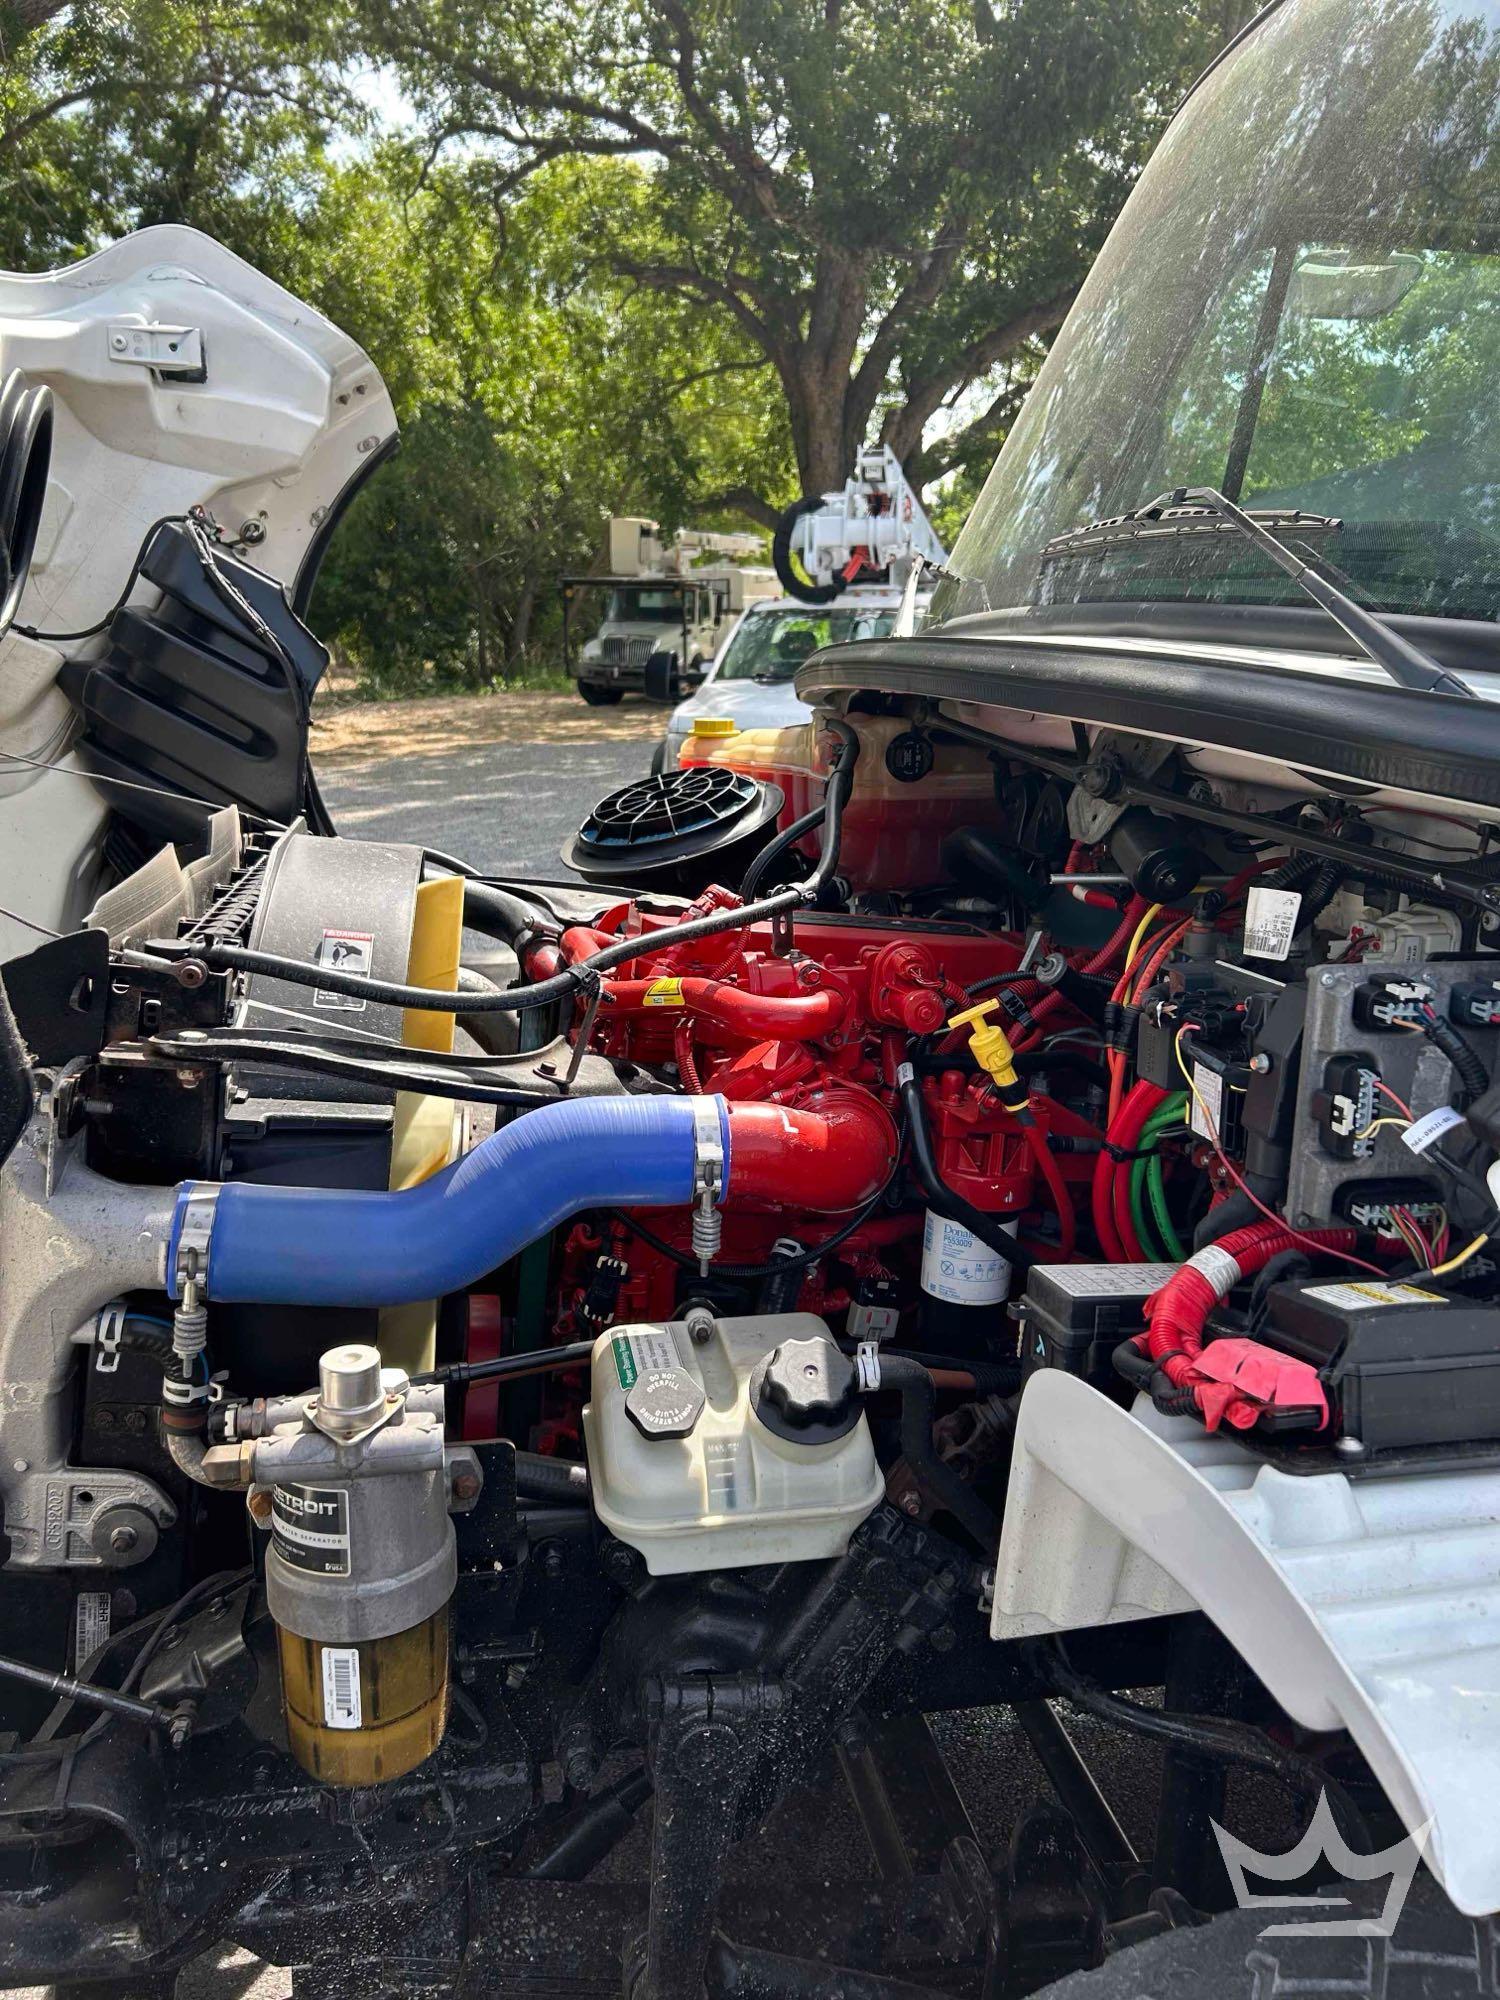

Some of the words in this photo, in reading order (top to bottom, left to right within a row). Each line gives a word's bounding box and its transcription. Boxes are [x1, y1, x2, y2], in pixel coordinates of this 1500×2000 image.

[335, 930, 371, 940] DANGER
[648, 1373, 660, 1383] DO
[661, 1372, 677, 1381] NOT
[646, 1379, 680, 1394] OVERFILL
[639, 1407, 674, 1426] STEERING
[655, 1408, 680, 1417] FLUID
[674, 1403, 693, 1424] POWER
[300, 1534, 342, 1545] SEPARATOR
